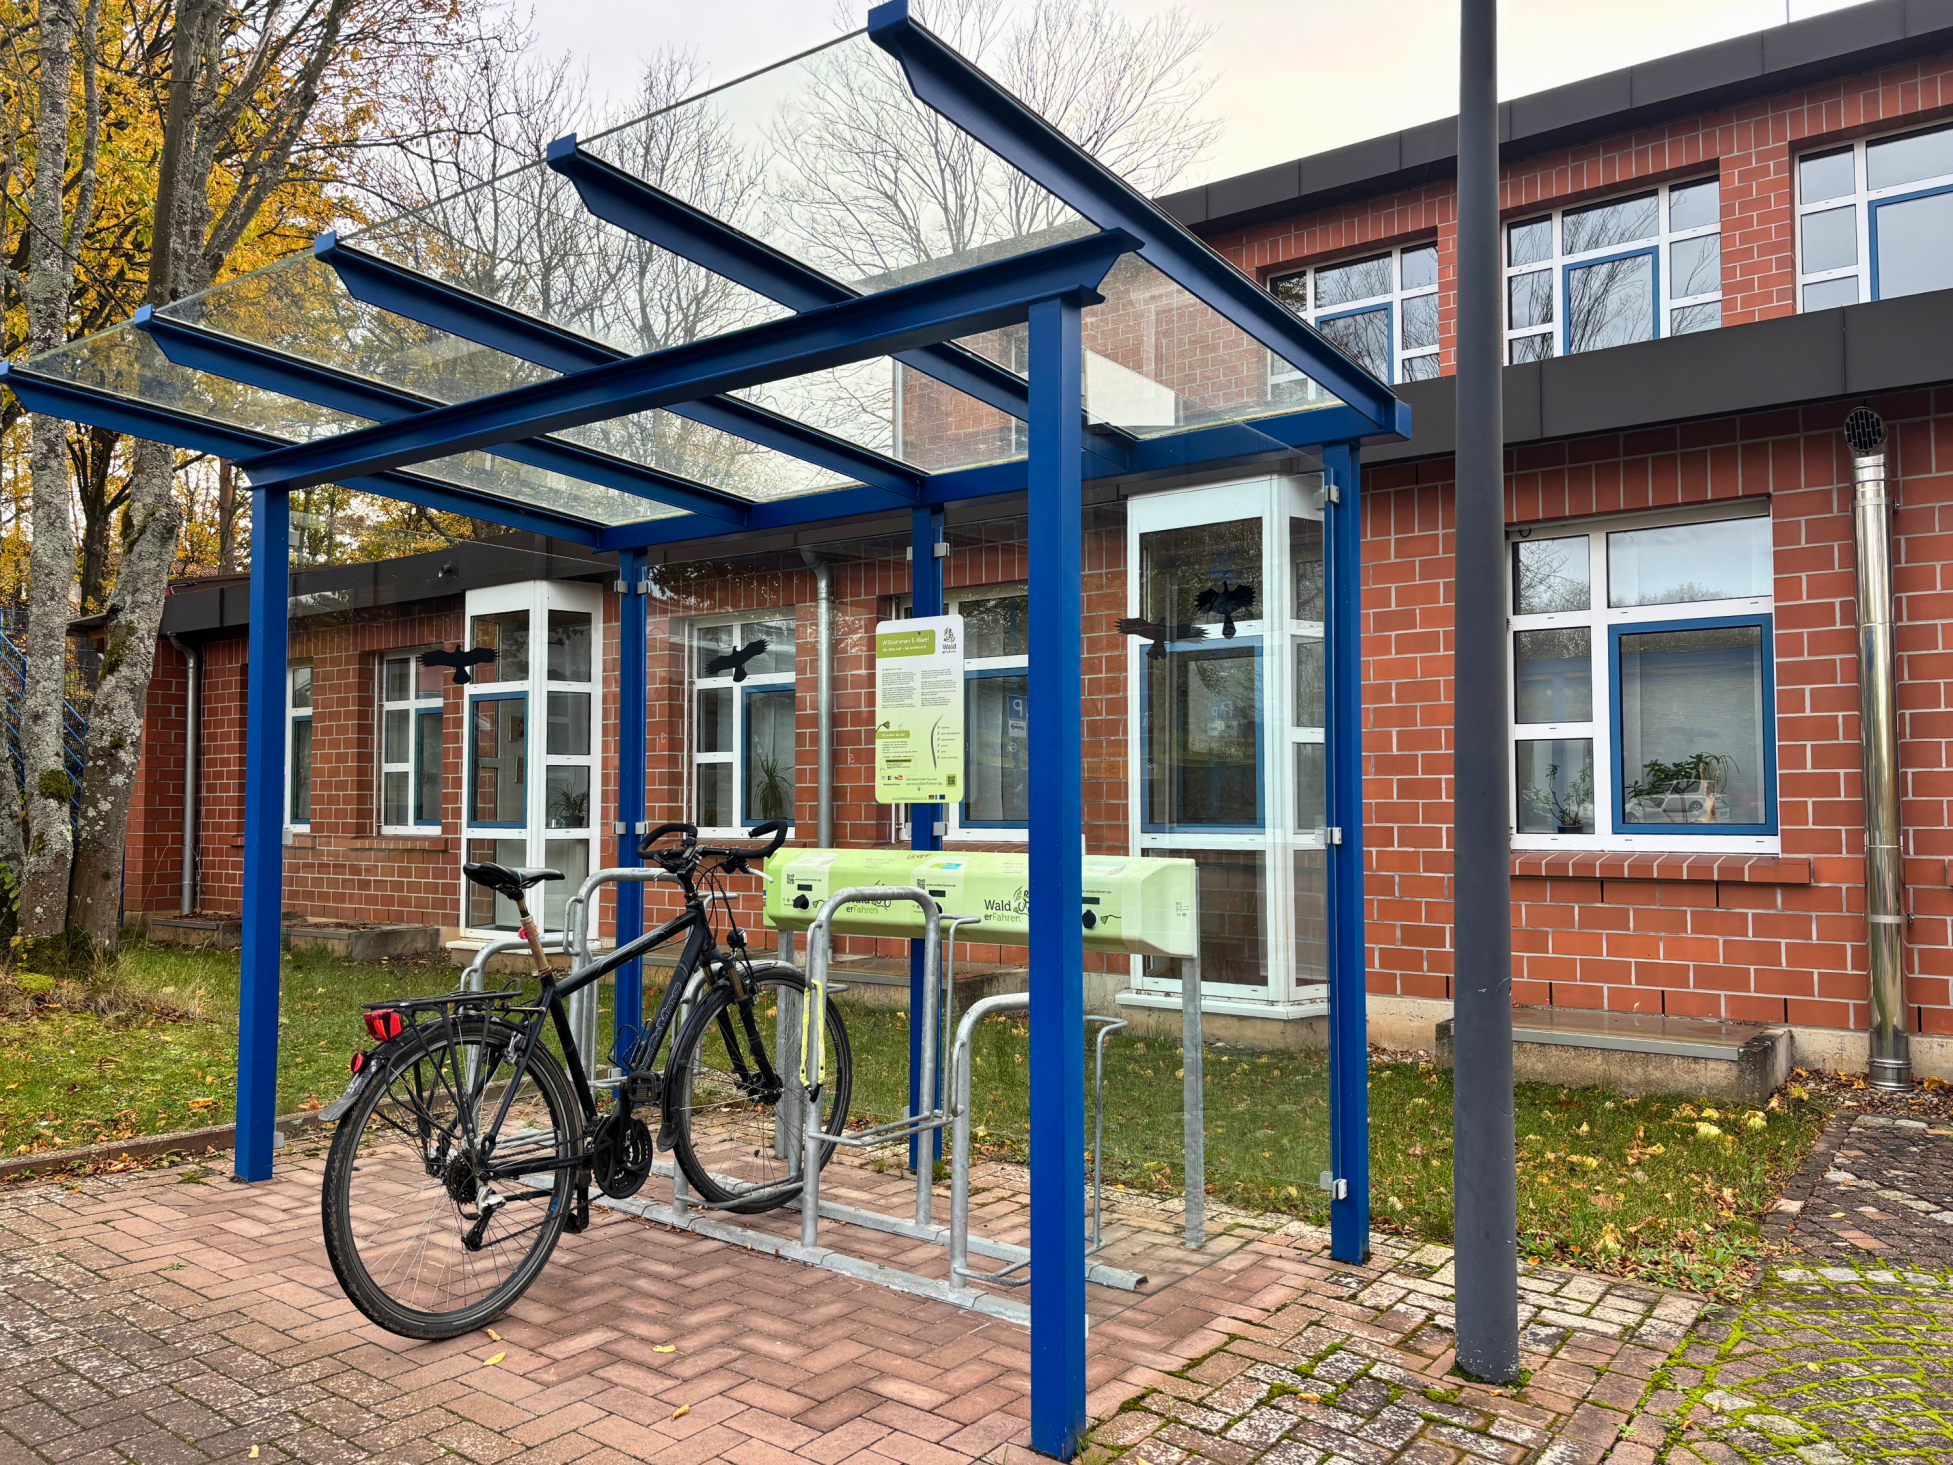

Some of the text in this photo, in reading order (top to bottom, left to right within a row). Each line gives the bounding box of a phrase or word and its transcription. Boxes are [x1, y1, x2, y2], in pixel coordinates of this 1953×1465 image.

[845, 905, 879, 915] erFahren
[984, 899, 1012, 912] Wald
[984, 912, 1021, 923] erFahren
